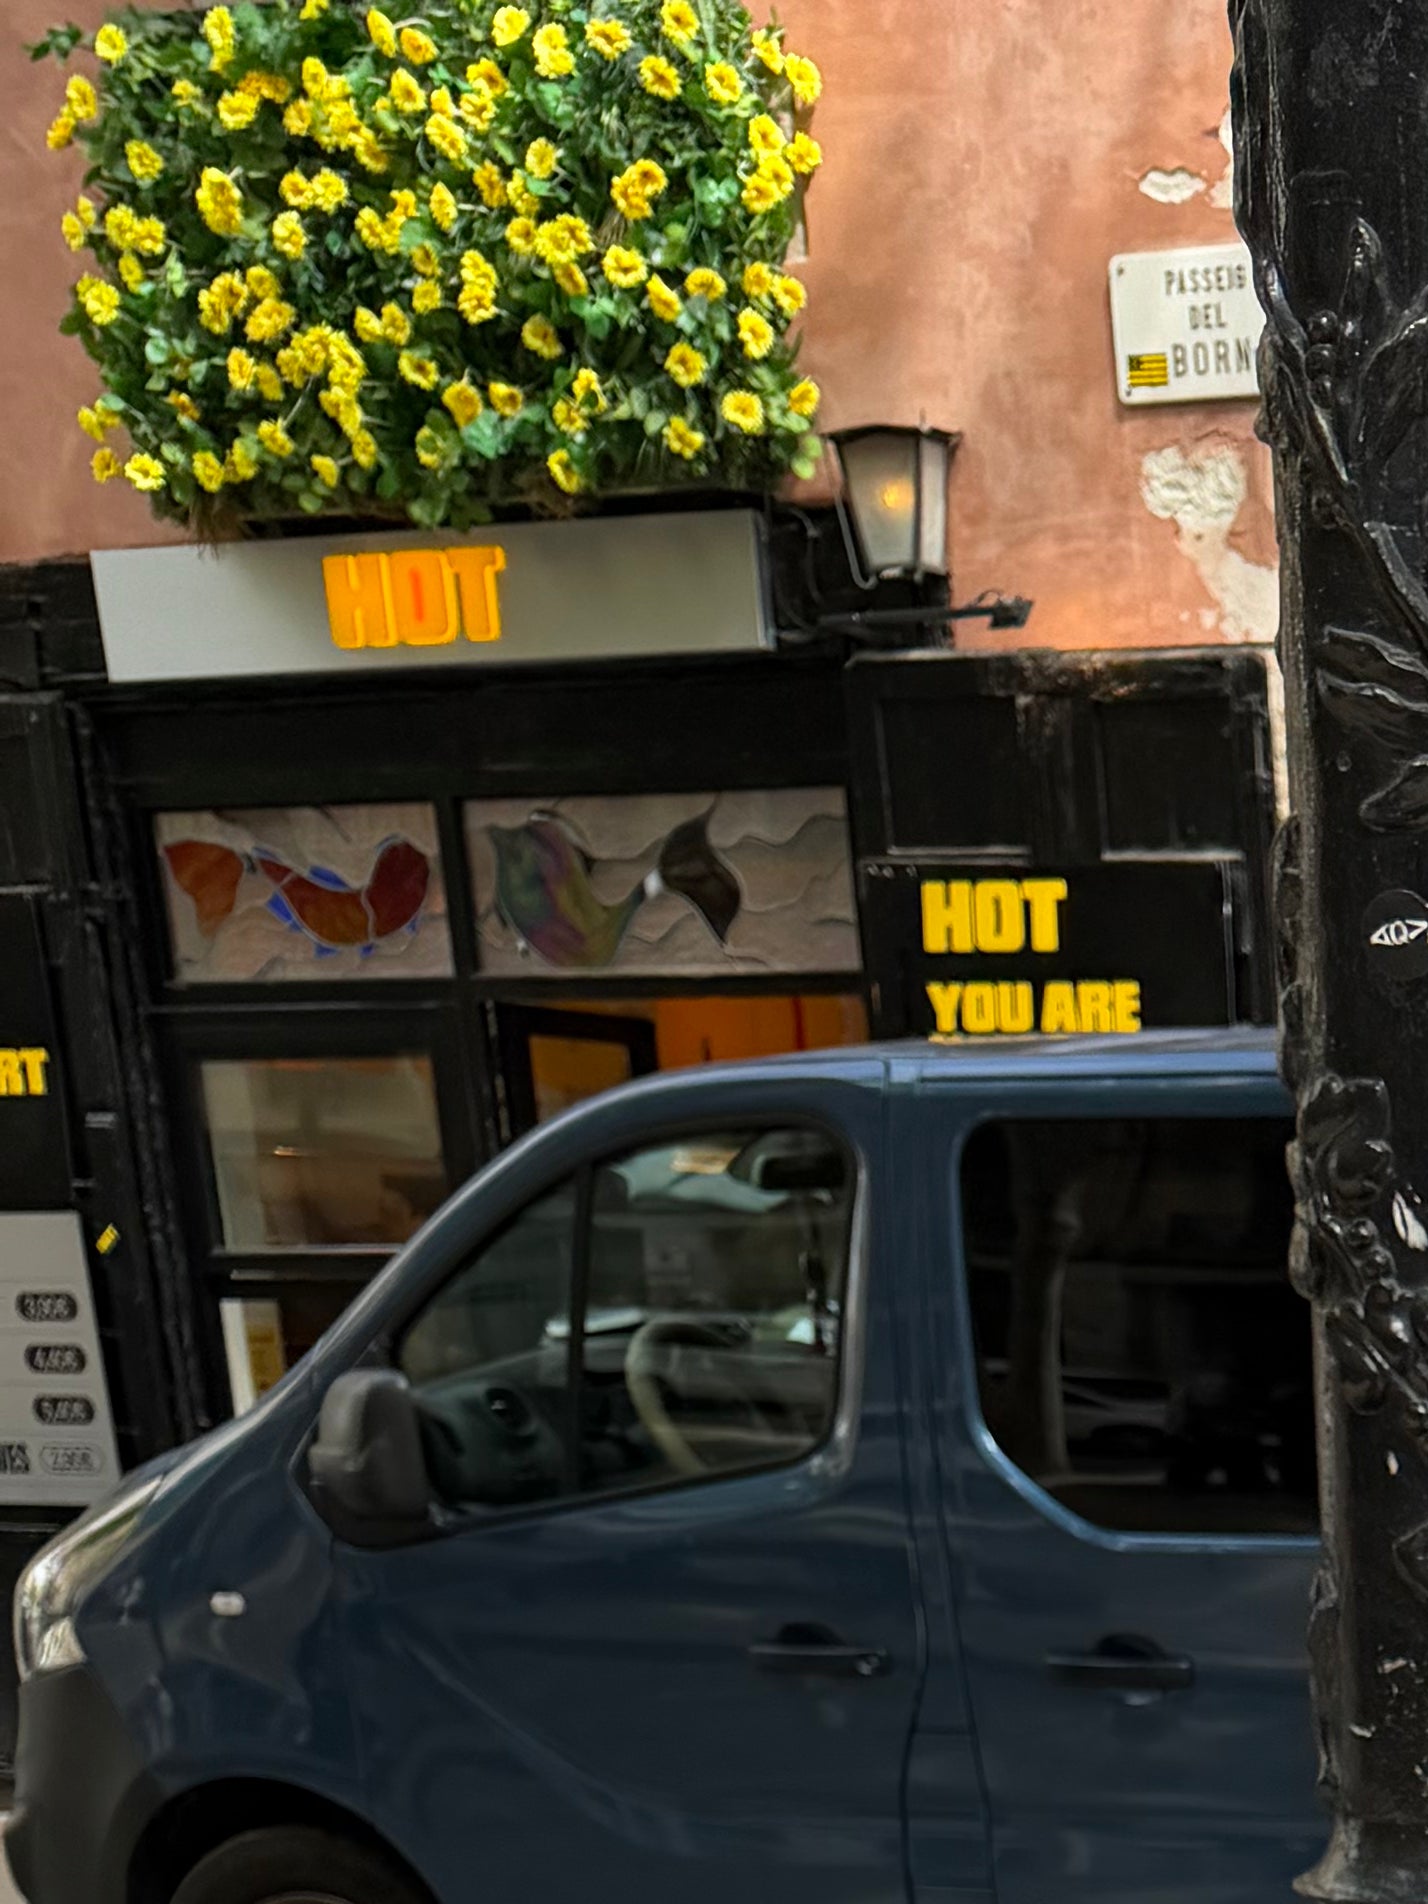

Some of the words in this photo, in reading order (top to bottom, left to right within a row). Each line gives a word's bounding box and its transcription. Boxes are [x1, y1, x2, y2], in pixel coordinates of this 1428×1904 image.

[1164, 264, 1247, 295] PASSEIG
[1188, 301, 1227, 330] DEL
[1171, 336, 1251, 378] BORN
[322, 545, 506, 649] HOT
[921, 877, 1068, 953] HOT
[925, 980, 1034, 1033] YOU
[1041, 979, 1141, 1033] ARE
